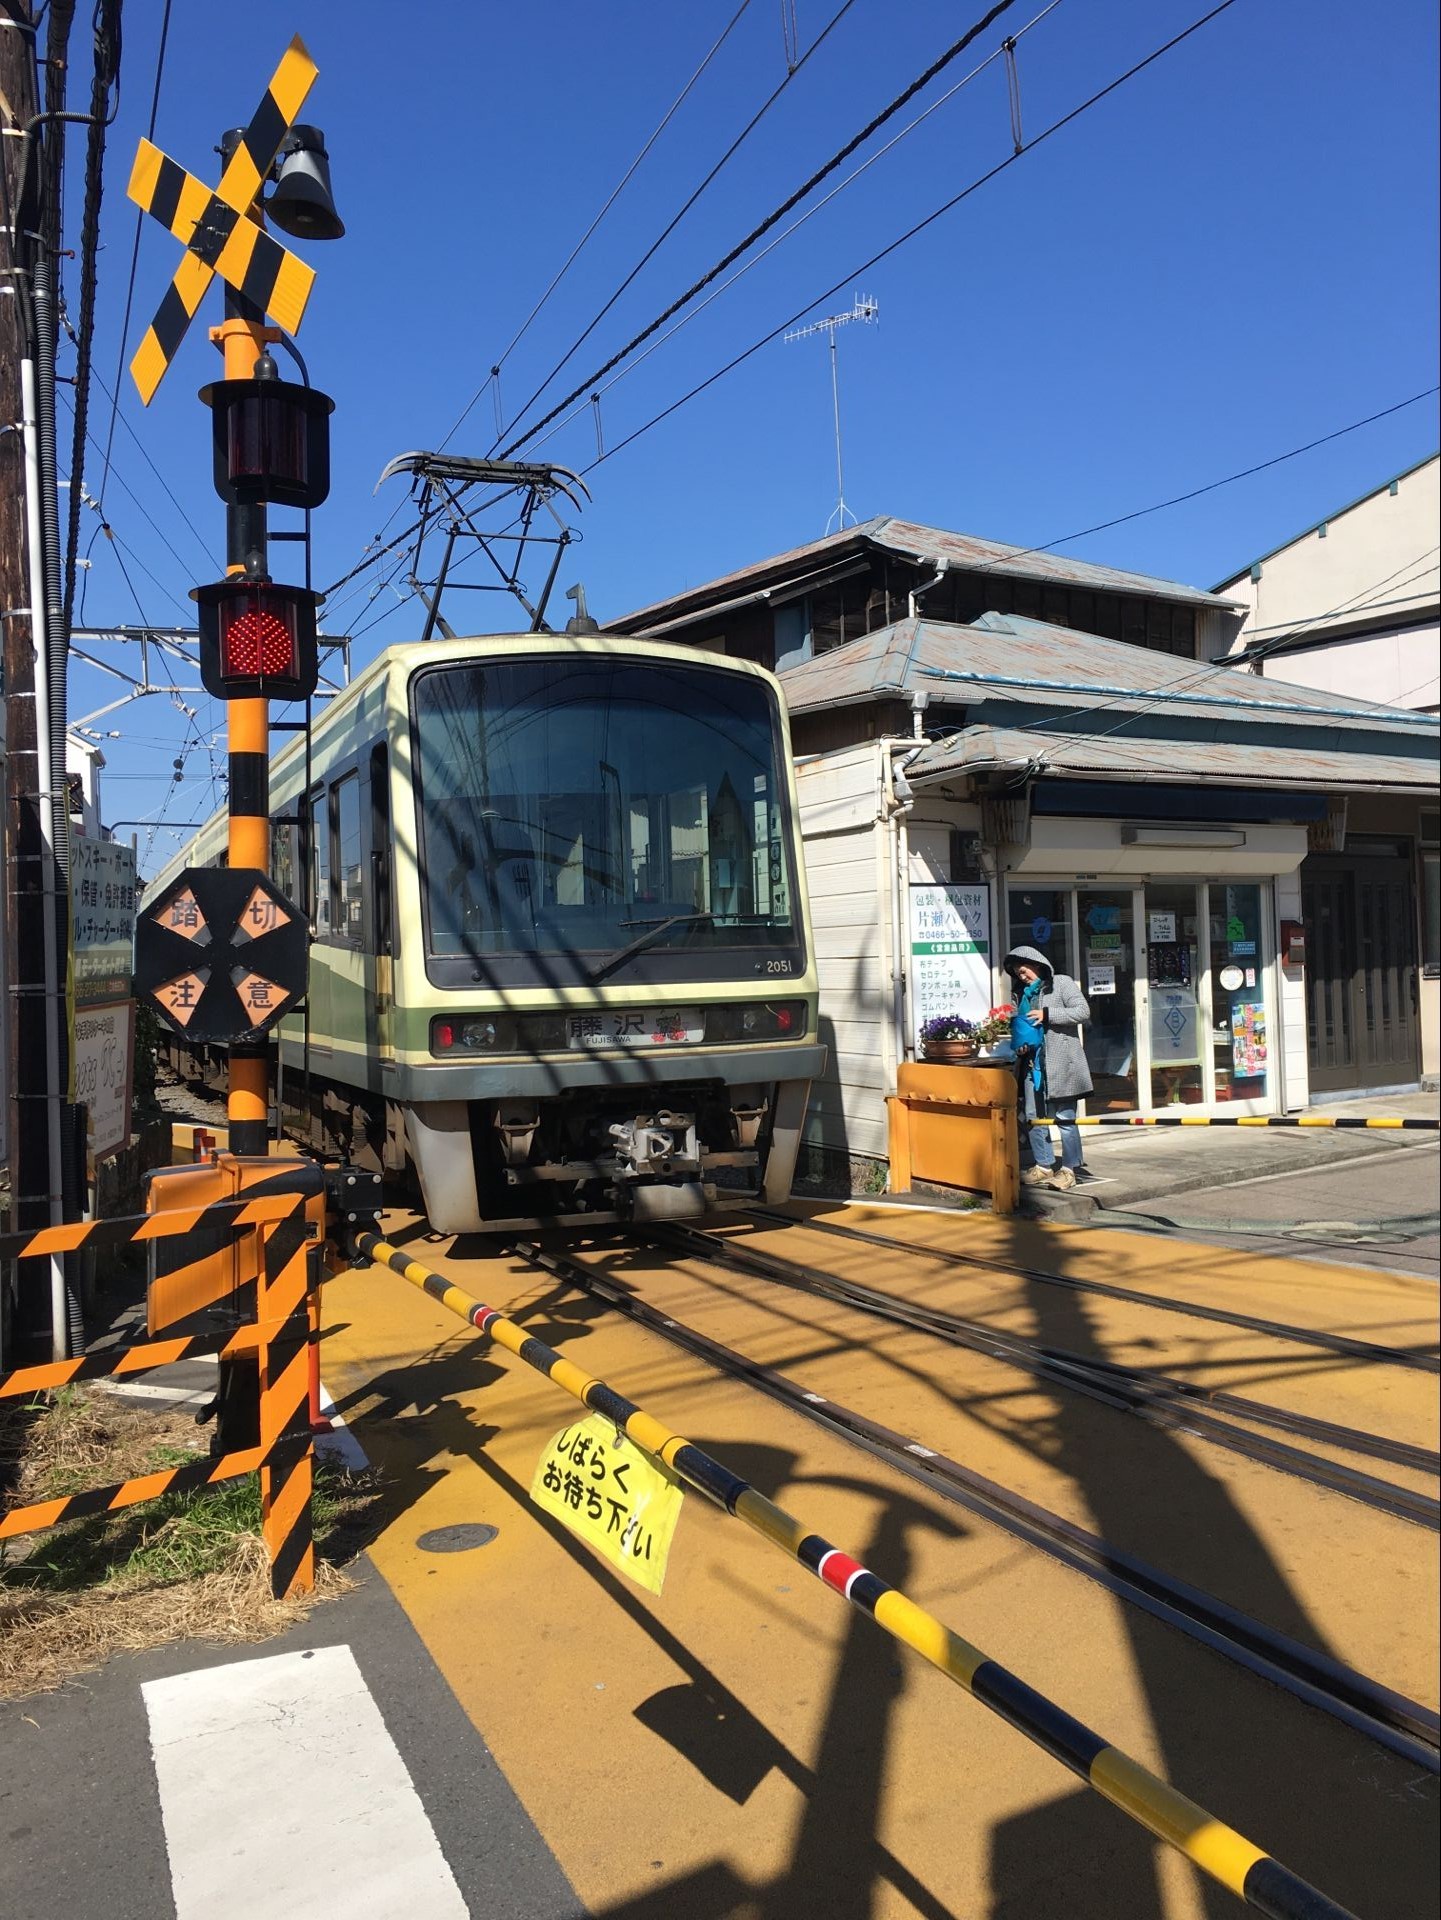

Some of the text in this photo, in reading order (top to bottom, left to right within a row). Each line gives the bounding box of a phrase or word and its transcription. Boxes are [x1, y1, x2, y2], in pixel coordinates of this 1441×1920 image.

[767, 960, 792, 973] 2051
[569, 1013, 645, 1038] 藤沢
[586, 1035, 632, 1045] FUJISAWA
[556, 1429, 631, 1495] しばらく
[542, 1459, 653, 1560] お待ち下さい
